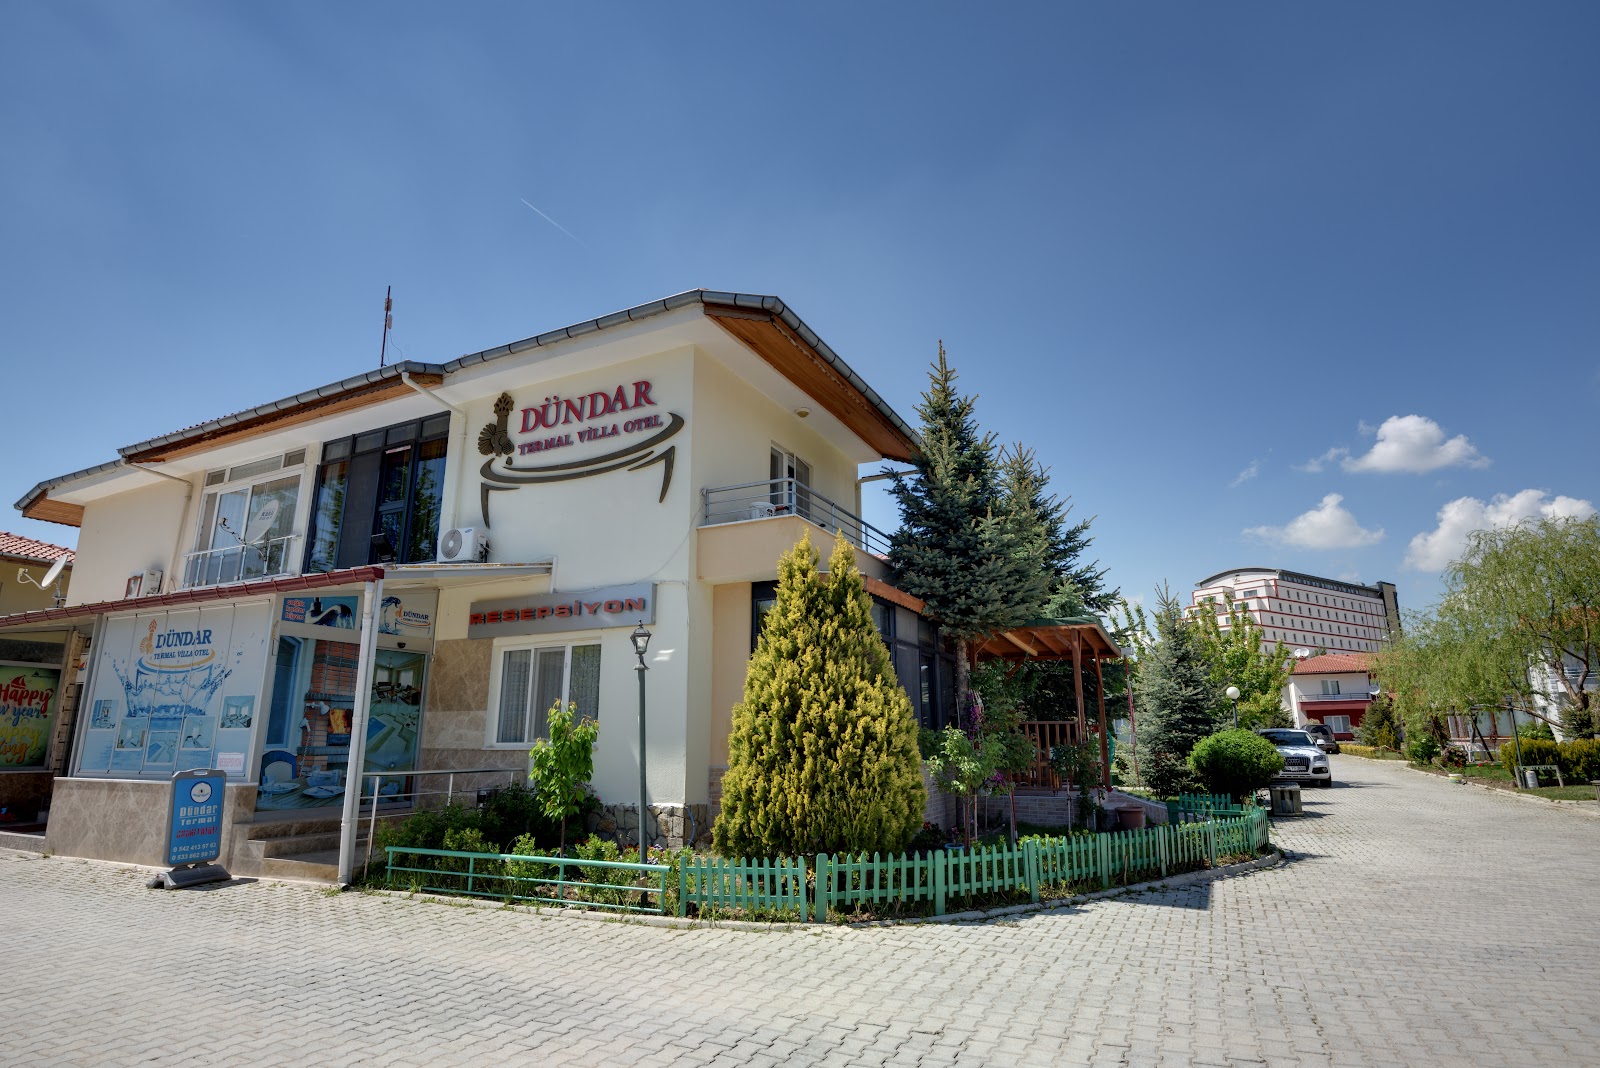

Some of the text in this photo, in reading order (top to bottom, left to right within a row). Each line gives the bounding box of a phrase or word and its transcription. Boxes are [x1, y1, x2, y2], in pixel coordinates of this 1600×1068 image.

[519, 381, 656, 433] DÜNDAR
[518, 435, 573, 455] TERMAL
[624, 415, 663, 433] OTEL
[403, 611, 429, 620] DÜNDAR
[470, 598, 644, 625] RESEPSİYON
[155, 629, 212, 649] DÜNDAR
[154, 651, 176, 660] TERMAL
[0, 683, 50, 714] Happy
[0, 726, 42, 751] appy
[180, 805, 217, 817] Dündar
[180, 816, 216, 826] Termal
